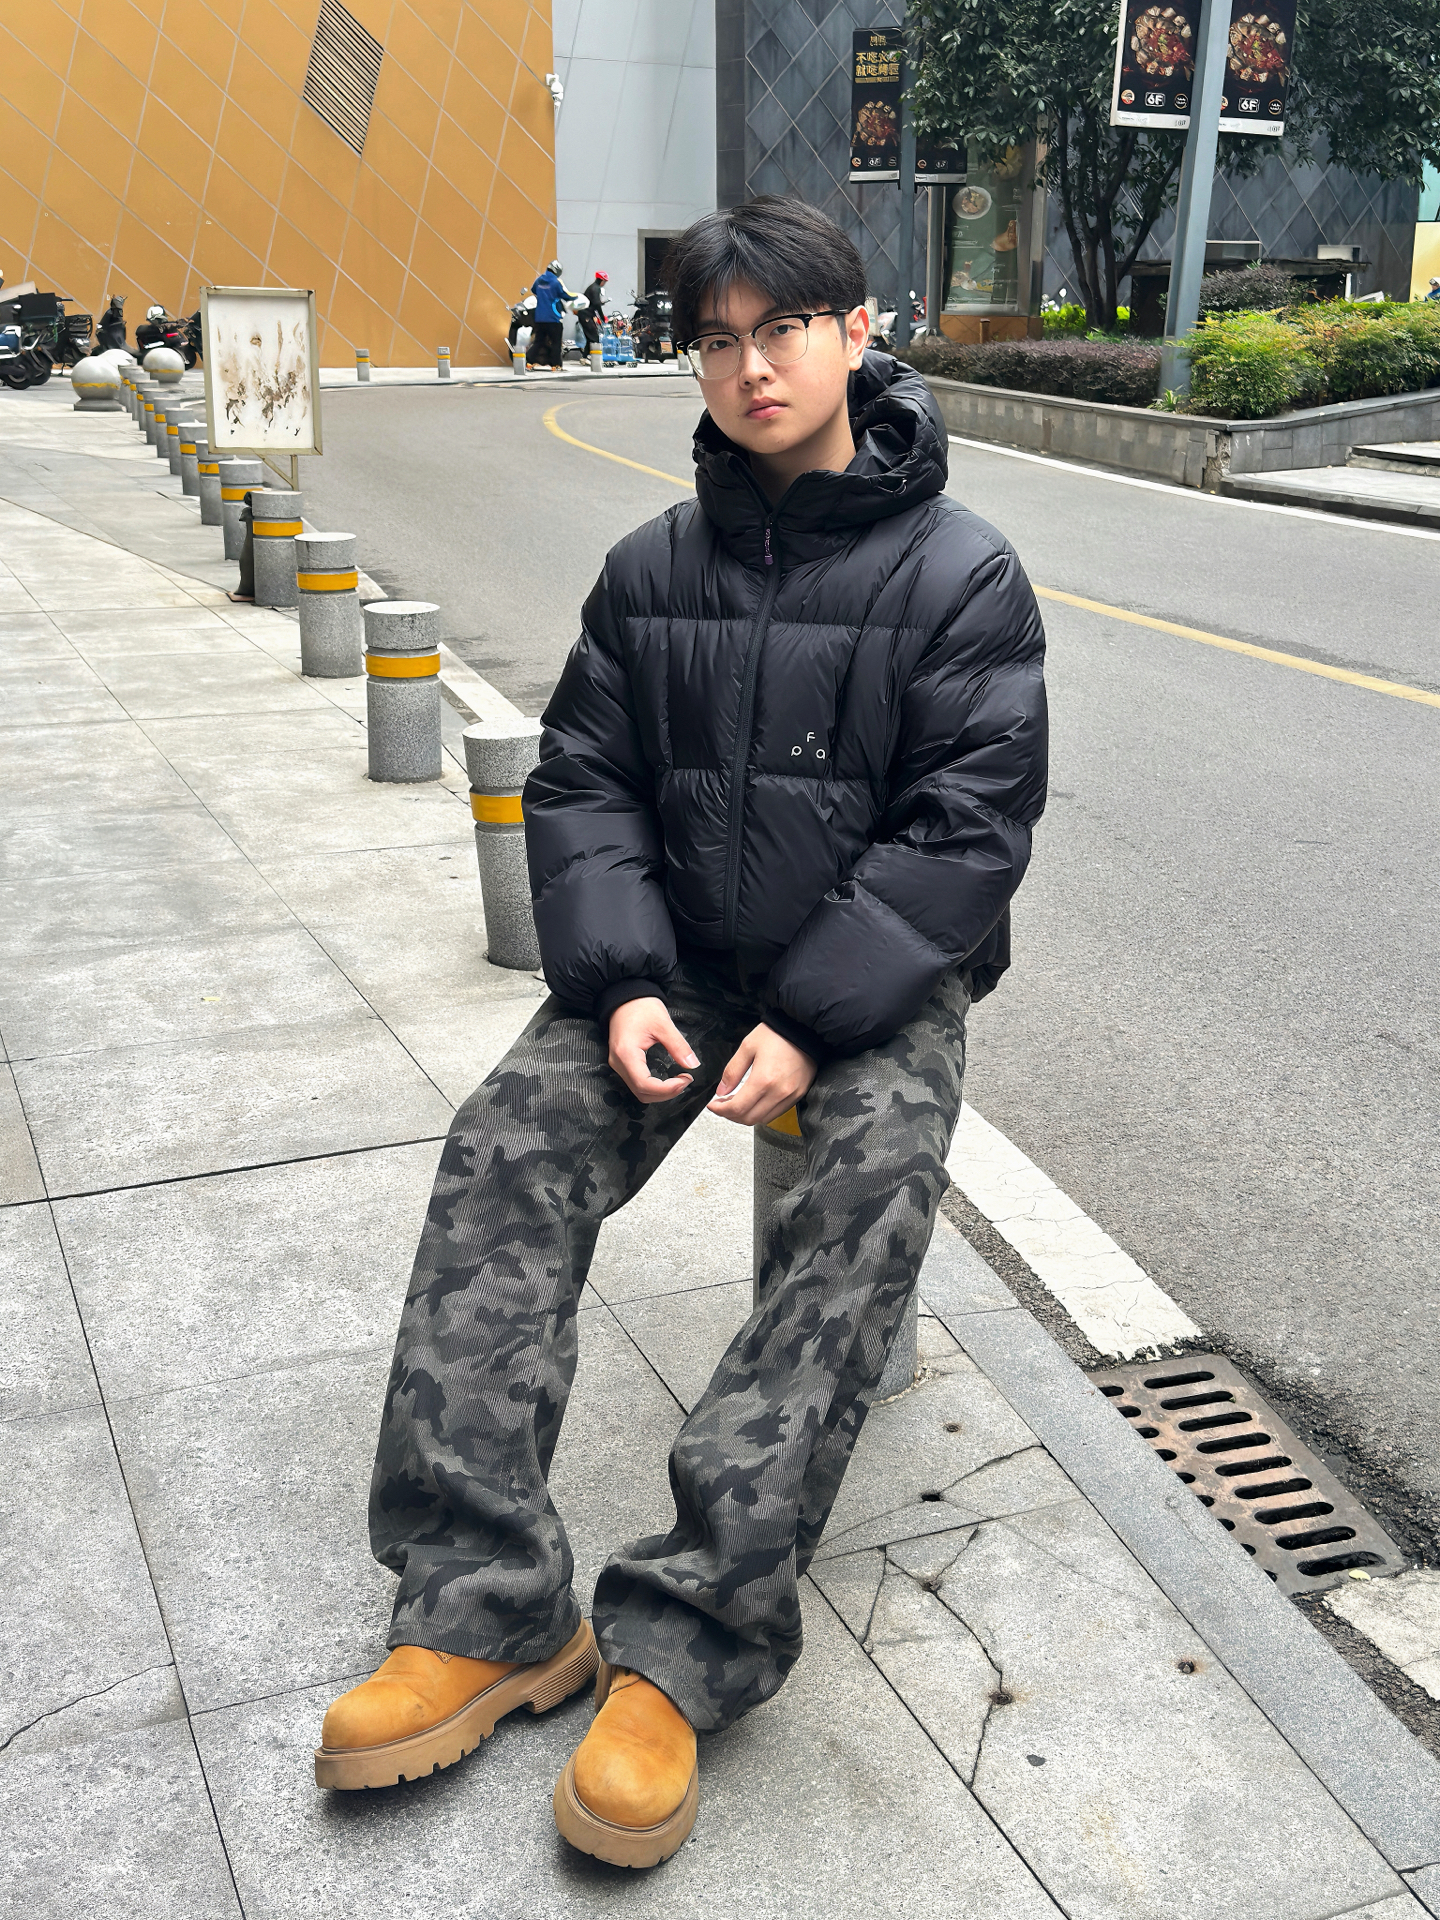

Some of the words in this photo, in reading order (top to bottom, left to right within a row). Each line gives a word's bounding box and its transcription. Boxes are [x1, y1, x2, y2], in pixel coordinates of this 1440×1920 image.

[855, 50, 898, 63] 不吃火
[1147, 94, 1163, 105] 6F
[1241, 99, 1258, 111] 6F
